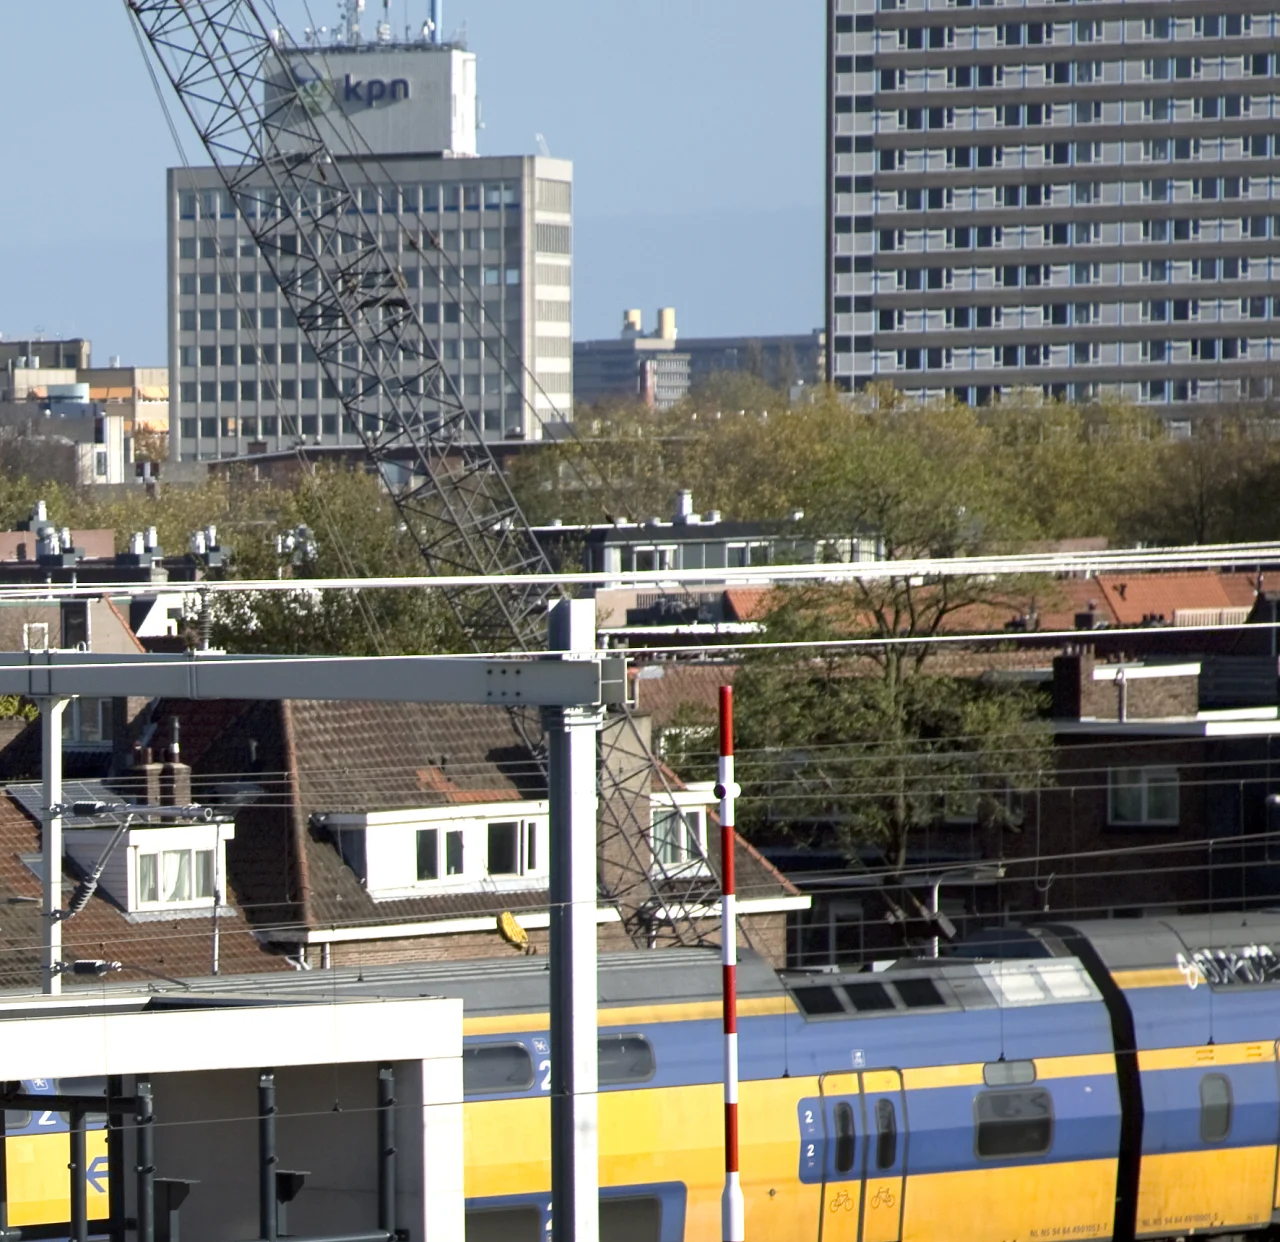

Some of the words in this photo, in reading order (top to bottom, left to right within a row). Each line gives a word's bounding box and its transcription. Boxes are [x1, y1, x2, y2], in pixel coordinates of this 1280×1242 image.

[344, 73, 410, 107] kpn
[805, 1110, 814, 1124] 2
[807, 1144, 815, 1157] 2
